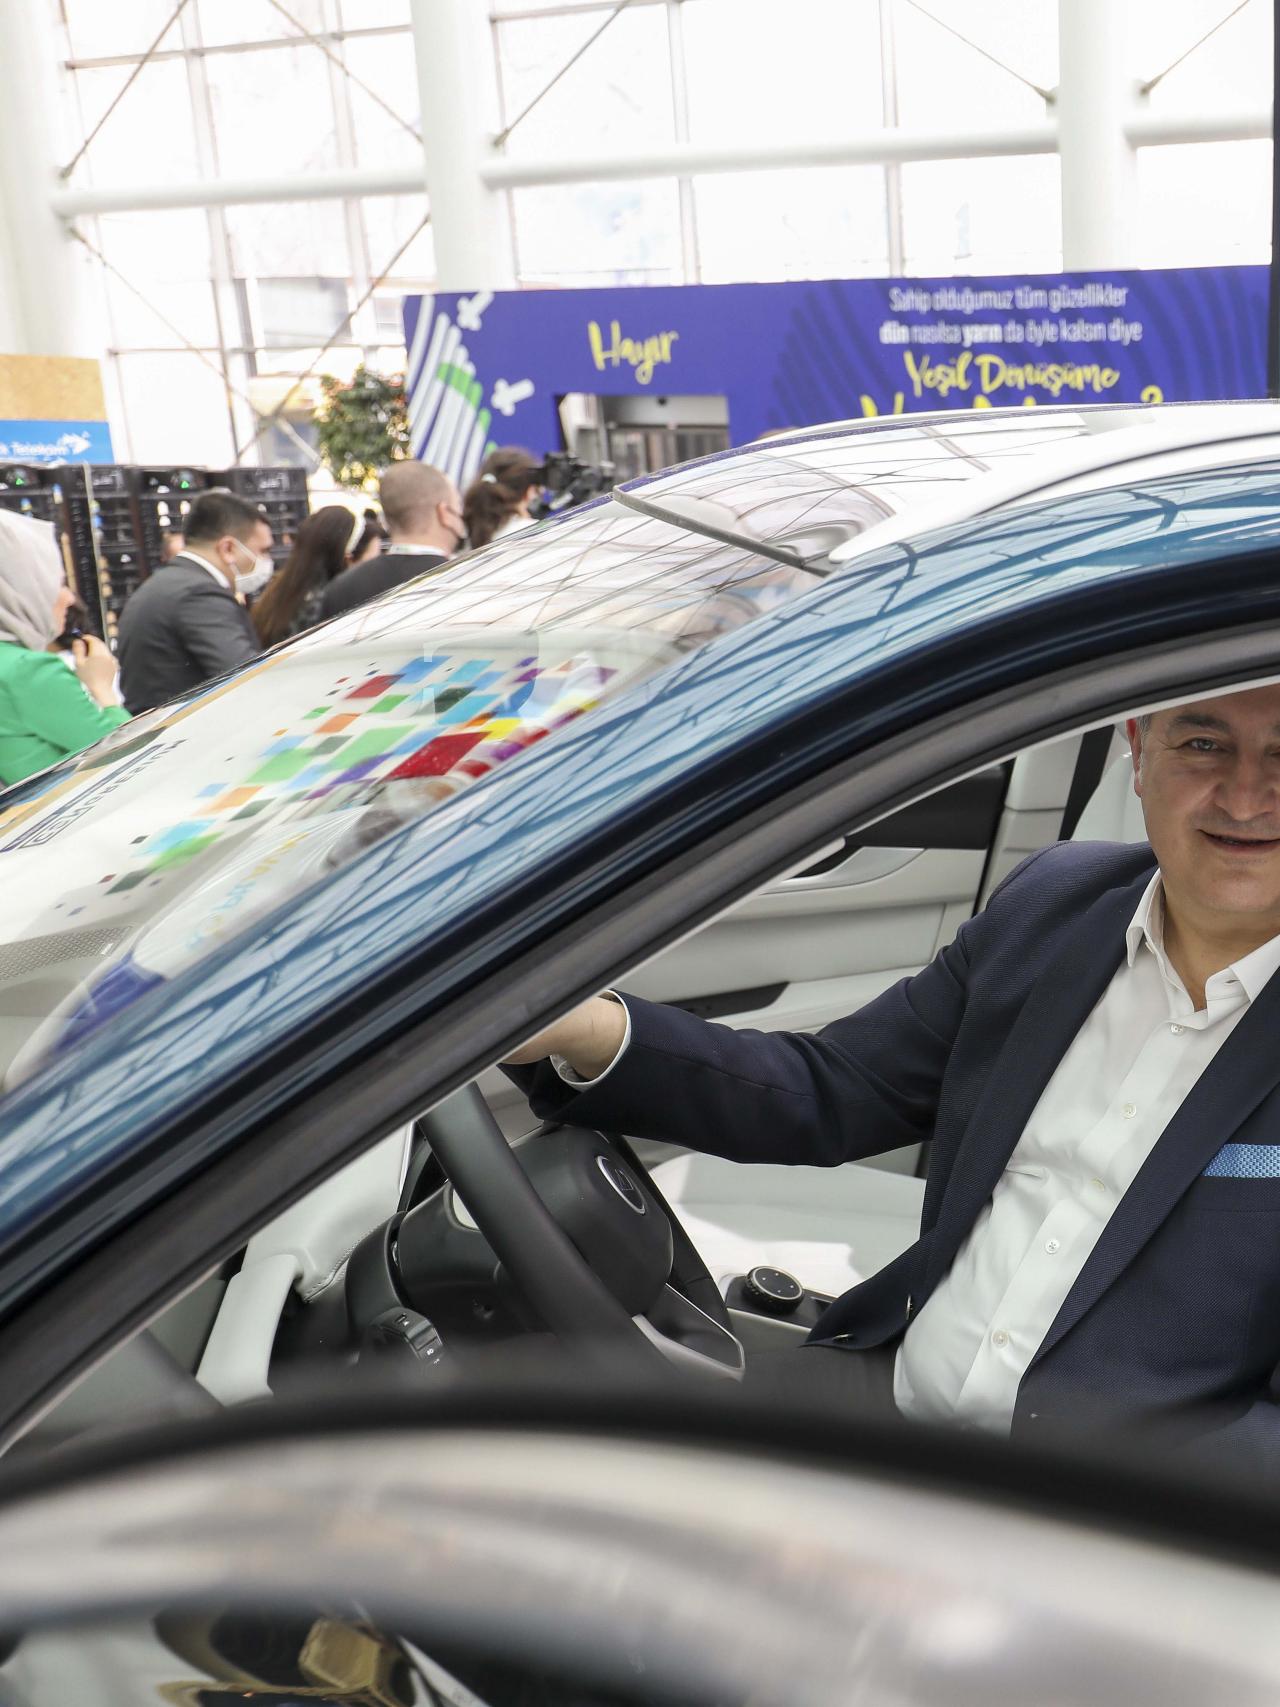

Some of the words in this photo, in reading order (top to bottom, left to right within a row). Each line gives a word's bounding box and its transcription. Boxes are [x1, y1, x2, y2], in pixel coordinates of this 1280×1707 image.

[888, 286, 931, 314] Sahip
[931, 286, 1014, 315] olduğumuz
[1014, 285, 1047, 309] tüm
[1048, 283, 1128, 313] güzellikler
[879, 319, 909, 344] dün
[1003, 319, 1024, 343] da
[1025, 318, 1059, 347] öyle
[1059, 318, 1106, 342] kalsın
[1107, 317, 1142, 346] diye
[903, 350, 973, 397] Yeşil
